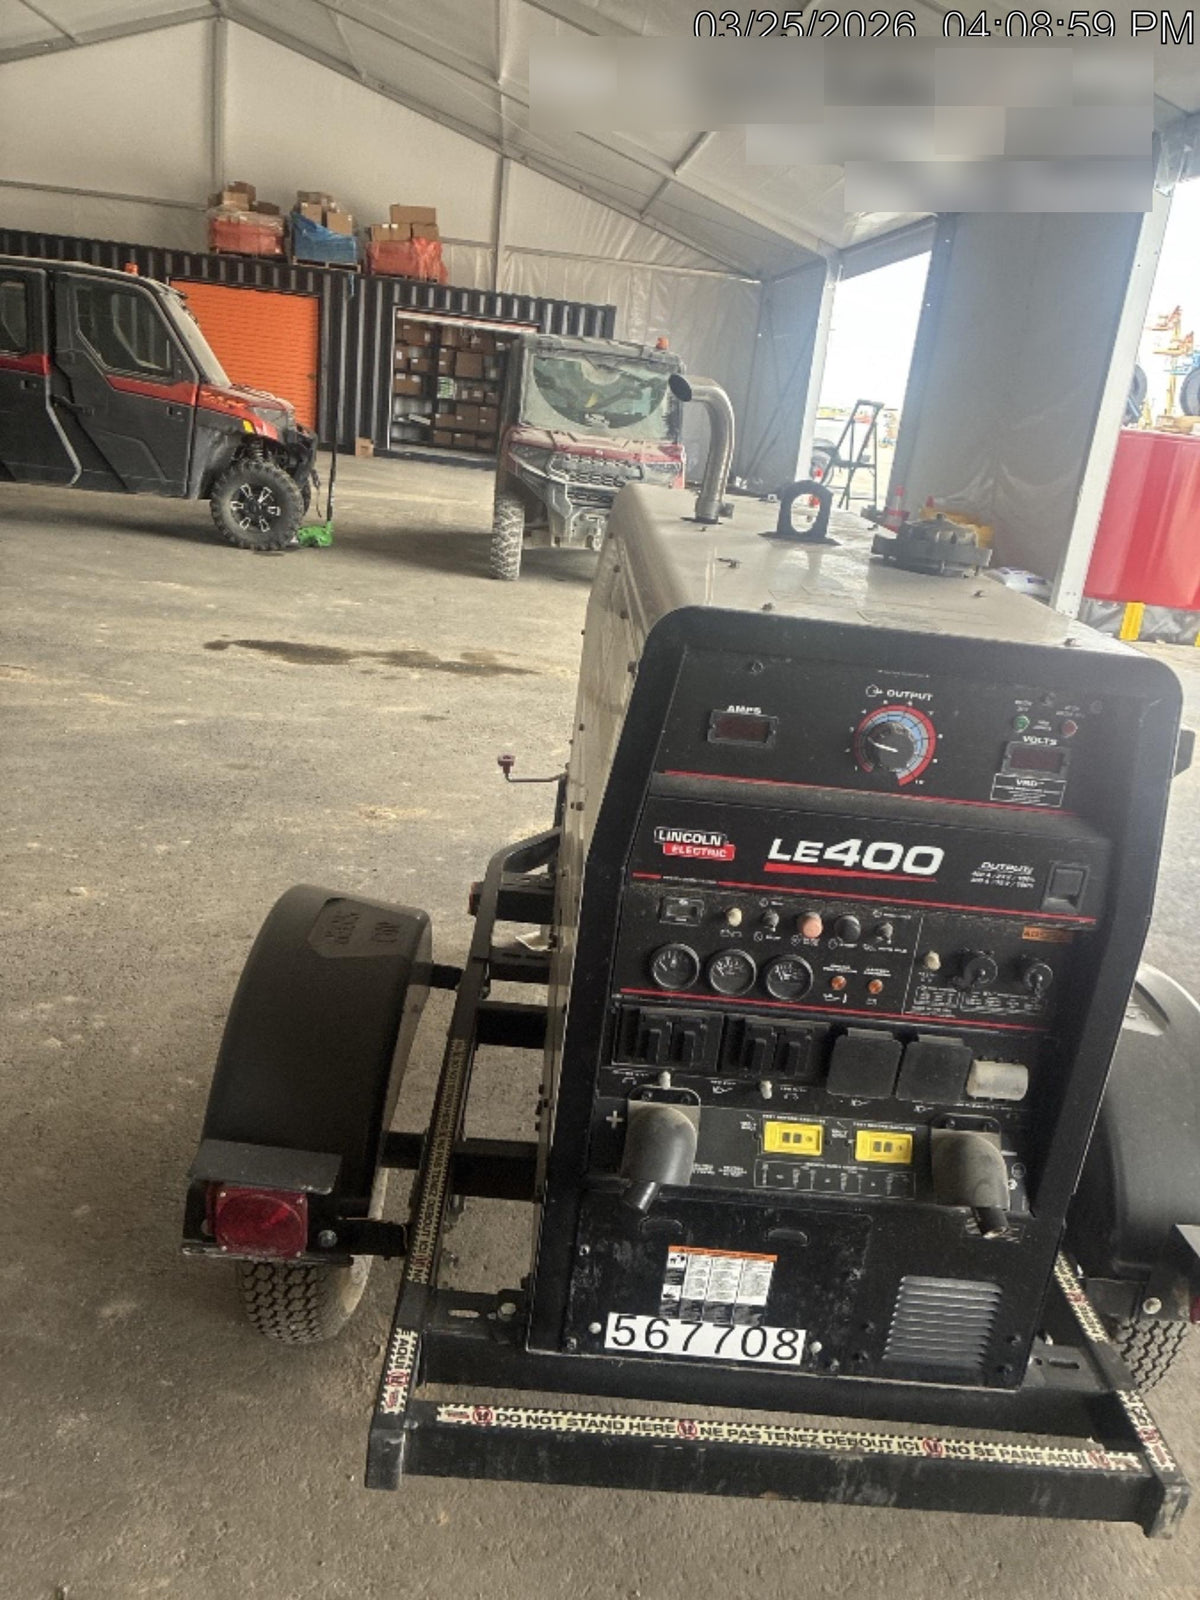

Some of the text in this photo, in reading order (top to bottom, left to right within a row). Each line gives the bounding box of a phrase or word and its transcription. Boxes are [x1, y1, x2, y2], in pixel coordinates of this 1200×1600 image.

[886, 689, 934, 701] OUTPUT
[1022, 735, 1057, 746] VOLTS
[659, 829, 722, 846] LINCOLN
[671, 844, 727, 858] ELECTRIC
[767, 838, 946, 876] LE400
[610, 1314, 800, 1361] 567708
[495, 1412, 677, 1434] DO NOT STAND HERE
[700, 1427, 920, 1452] NE PAS TENEZ DEBOUT ICI
[945, 1444, 970, 1456] NO
[975, 1446, 996, 1457] SE
[1000, 1448, 1044, 1461] PARE
